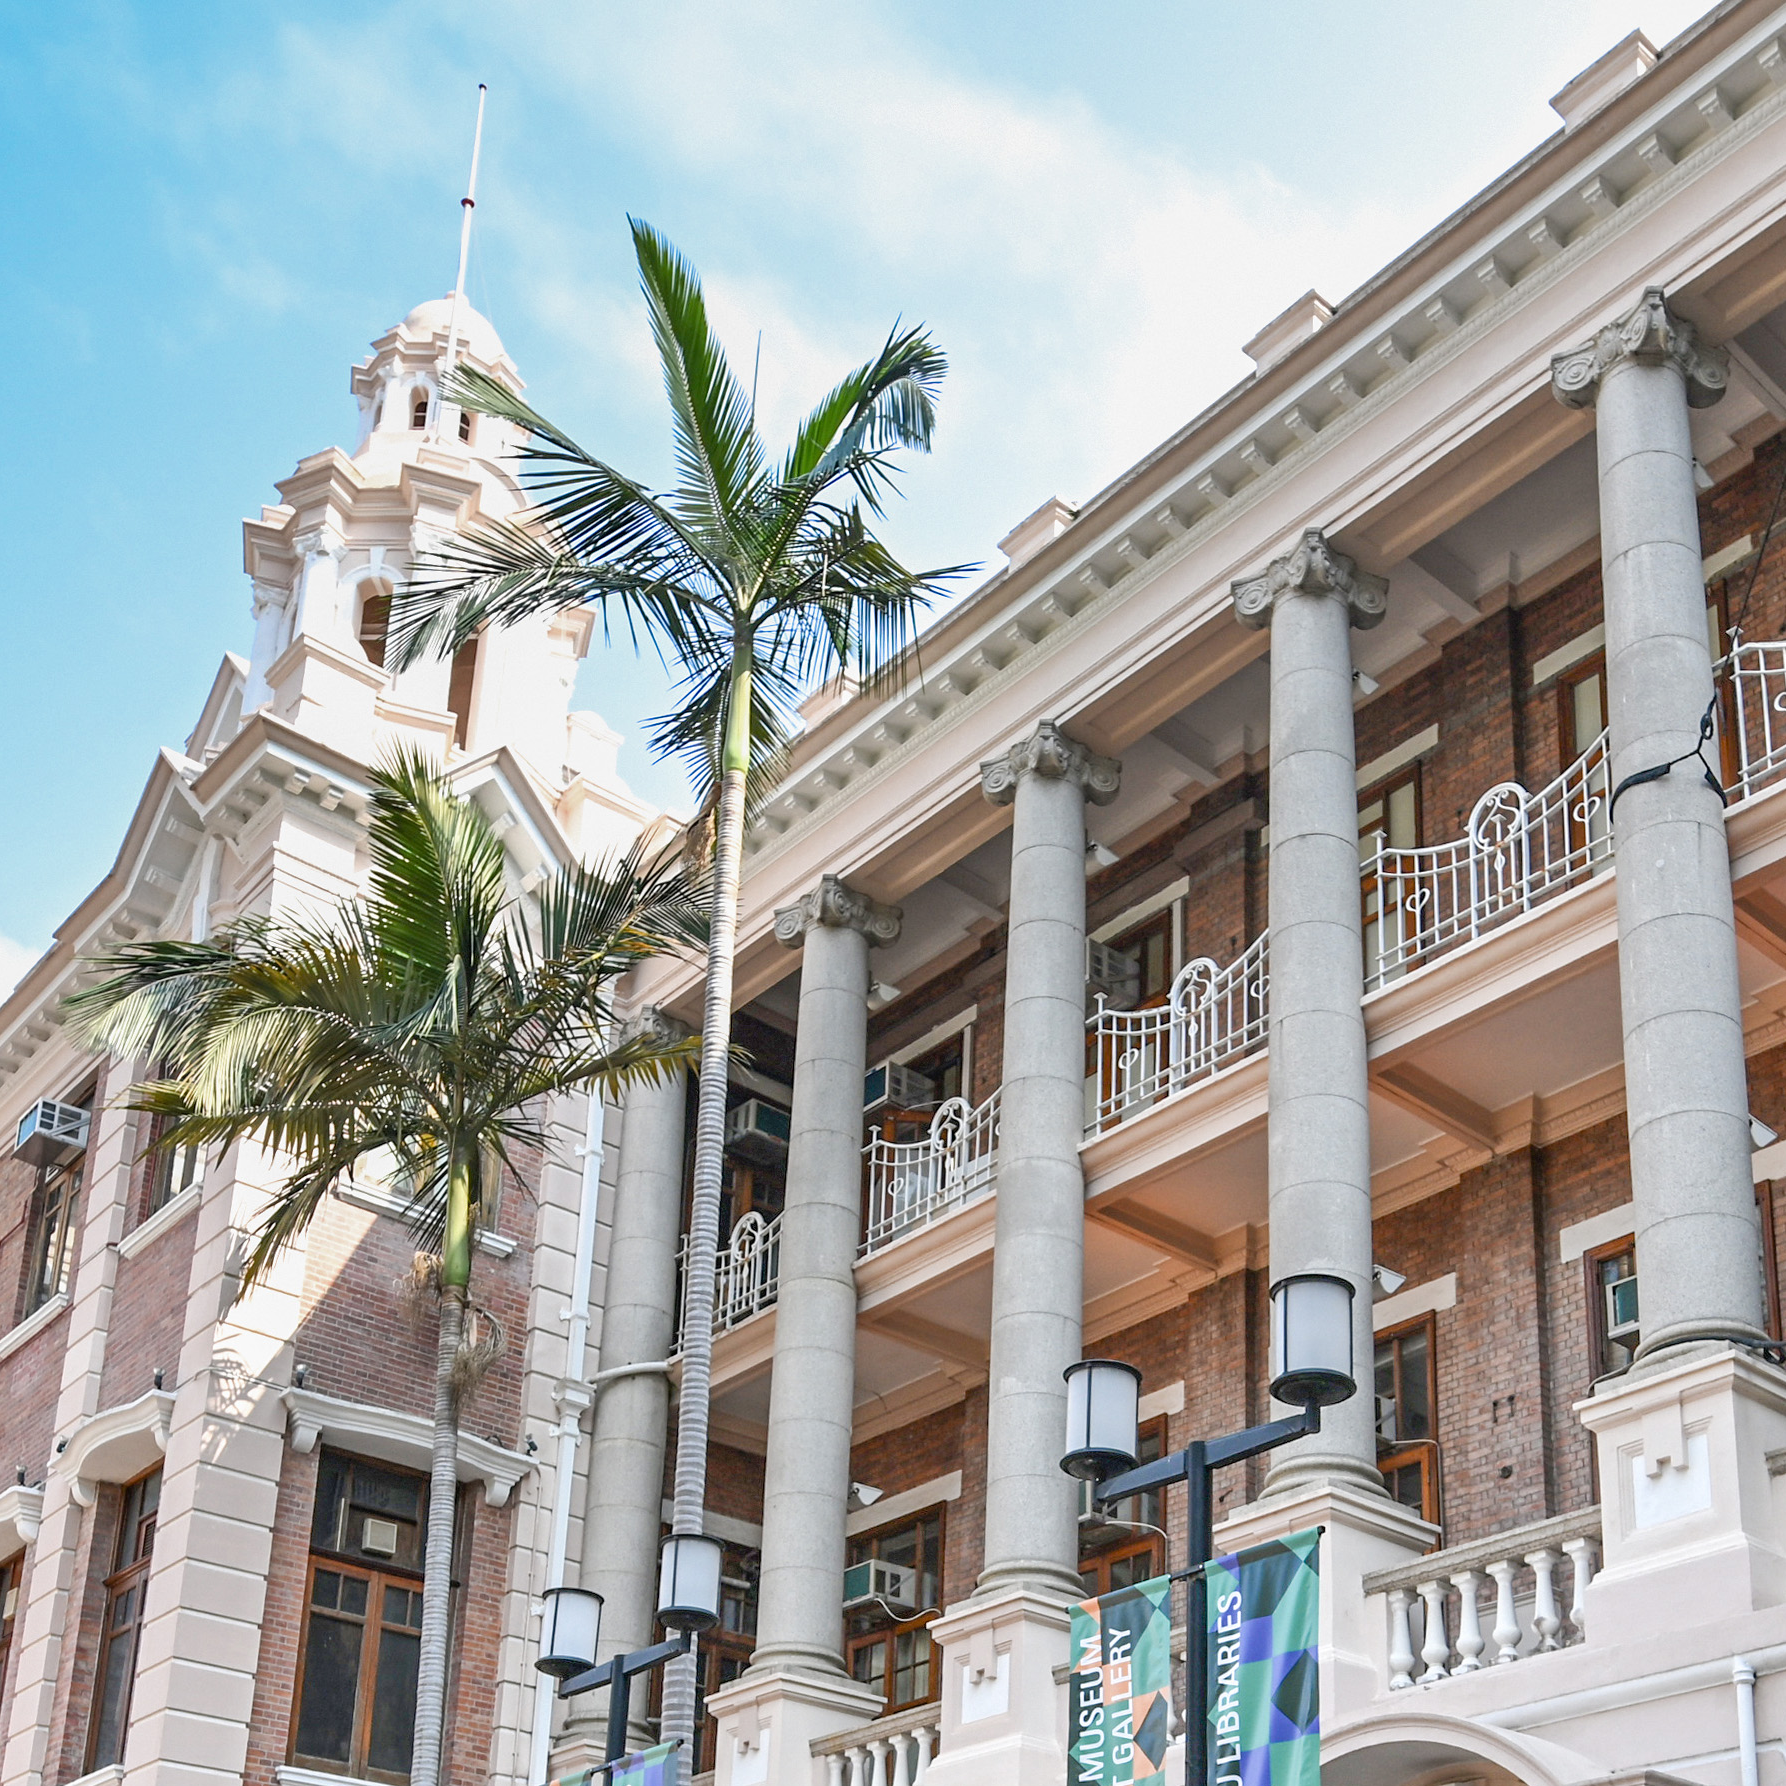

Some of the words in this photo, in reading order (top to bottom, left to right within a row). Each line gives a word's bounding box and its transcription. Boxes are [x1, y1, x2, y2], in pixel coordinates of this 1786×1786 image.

[1078, 1634, 1103, 1781] MUSEUM
[1109, 1628, 1133, 1764] GALLERY
[1216, 1590, 1243, 1760] LIBRARIES
